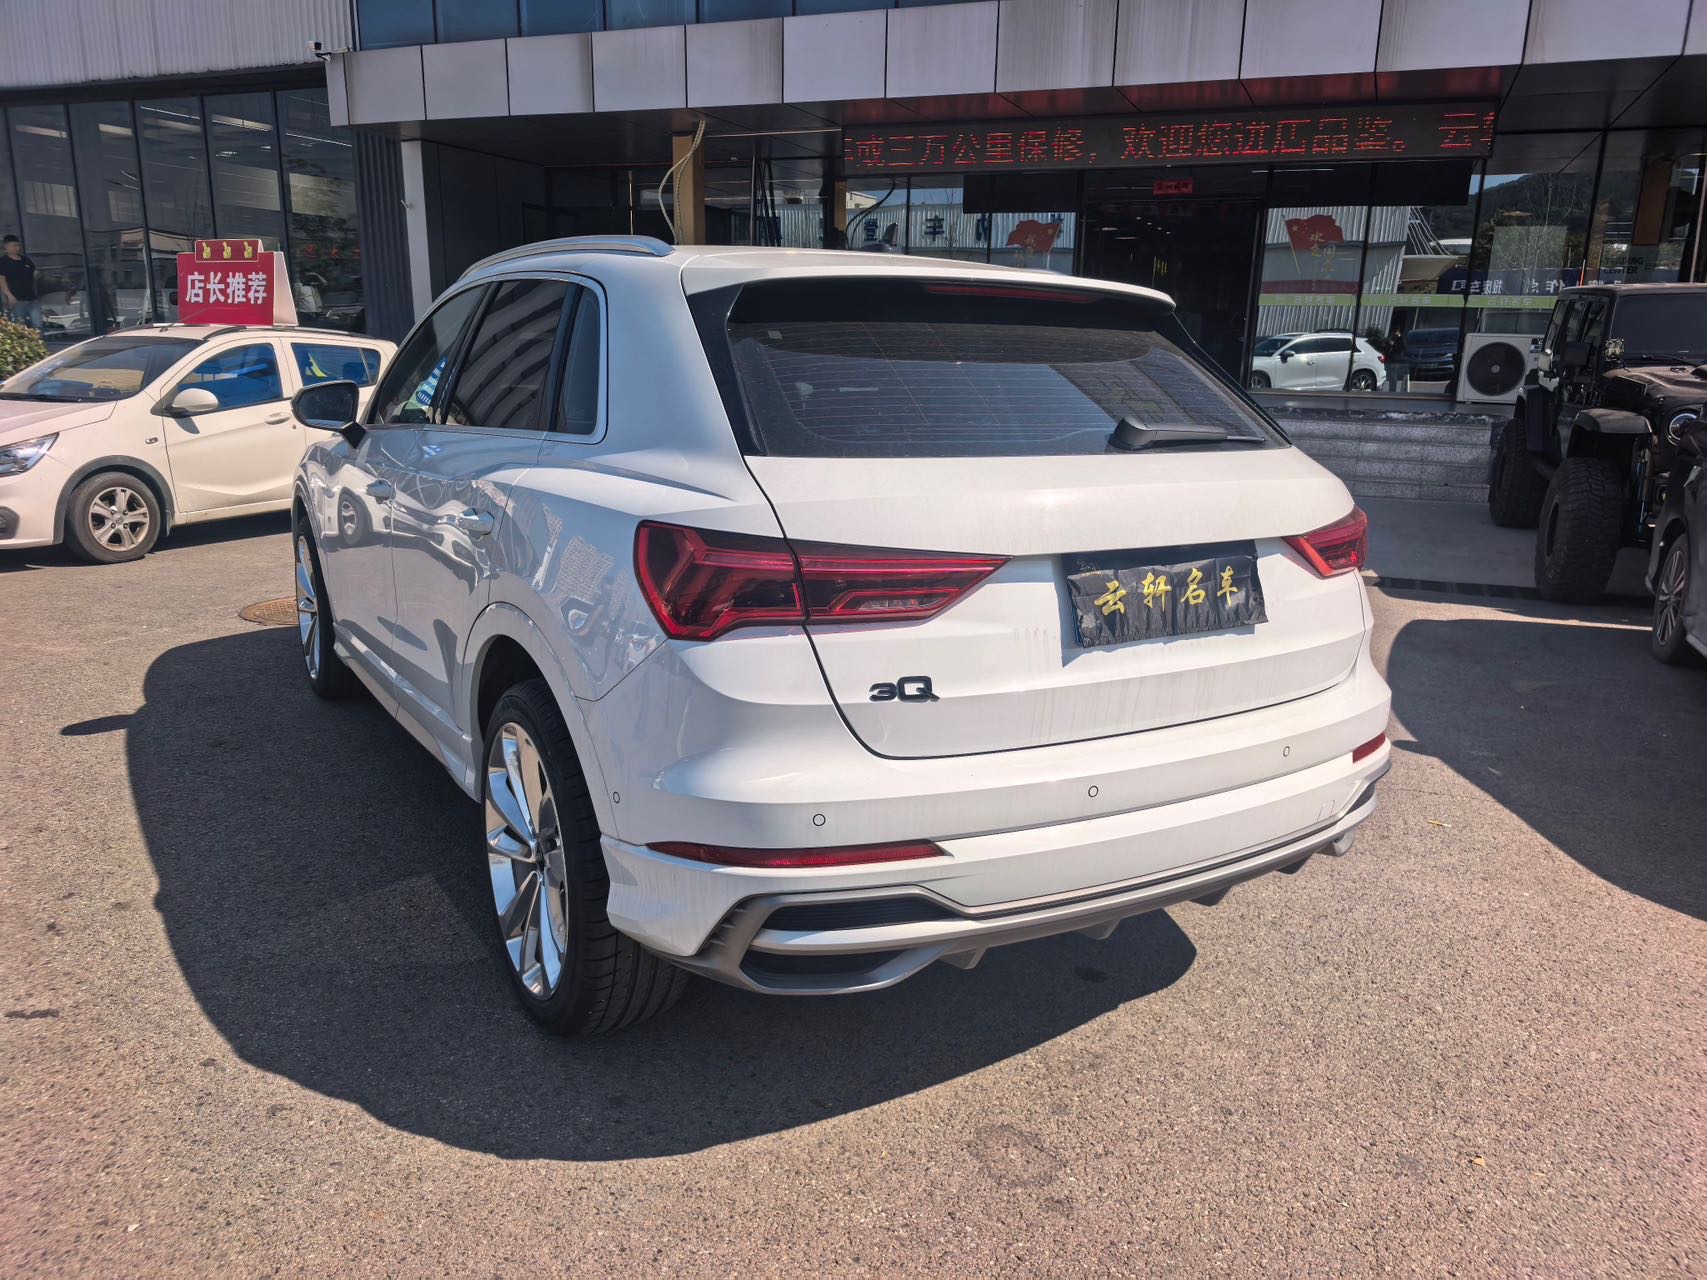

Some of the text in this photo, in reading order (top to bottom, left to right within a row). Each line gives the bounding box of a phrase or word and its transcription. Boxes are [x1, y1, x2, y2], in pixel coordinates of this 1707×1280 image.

[185, 271, 267, 304] 店长推荐
[1094, 565, 1239, 616] 云轩名车
